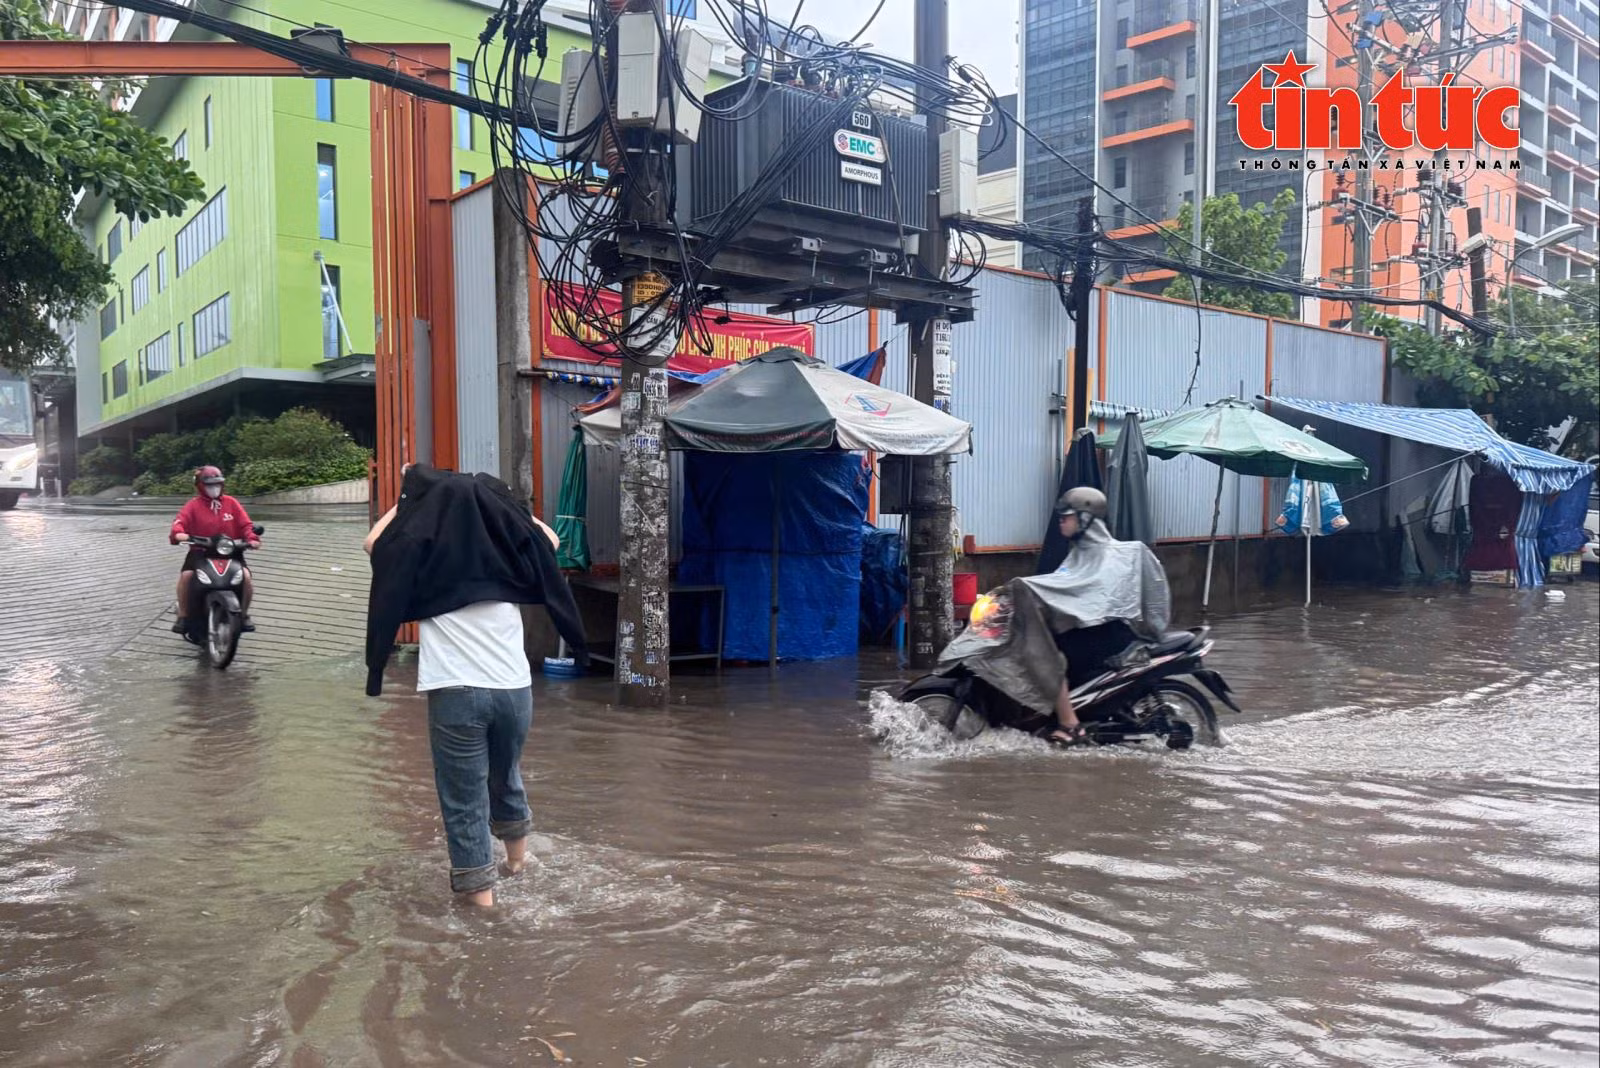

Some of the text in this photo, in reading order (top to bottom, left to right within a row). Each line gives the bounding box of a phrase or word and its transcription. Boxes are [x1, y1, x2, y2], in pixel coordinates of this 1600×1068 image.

[854, 113, 869, 127] 560
[849, 137, 875, 155] EMC
[844, 166, 879, 180] AMORPHOUS
[728, 331, 752, 362] PHÚC
